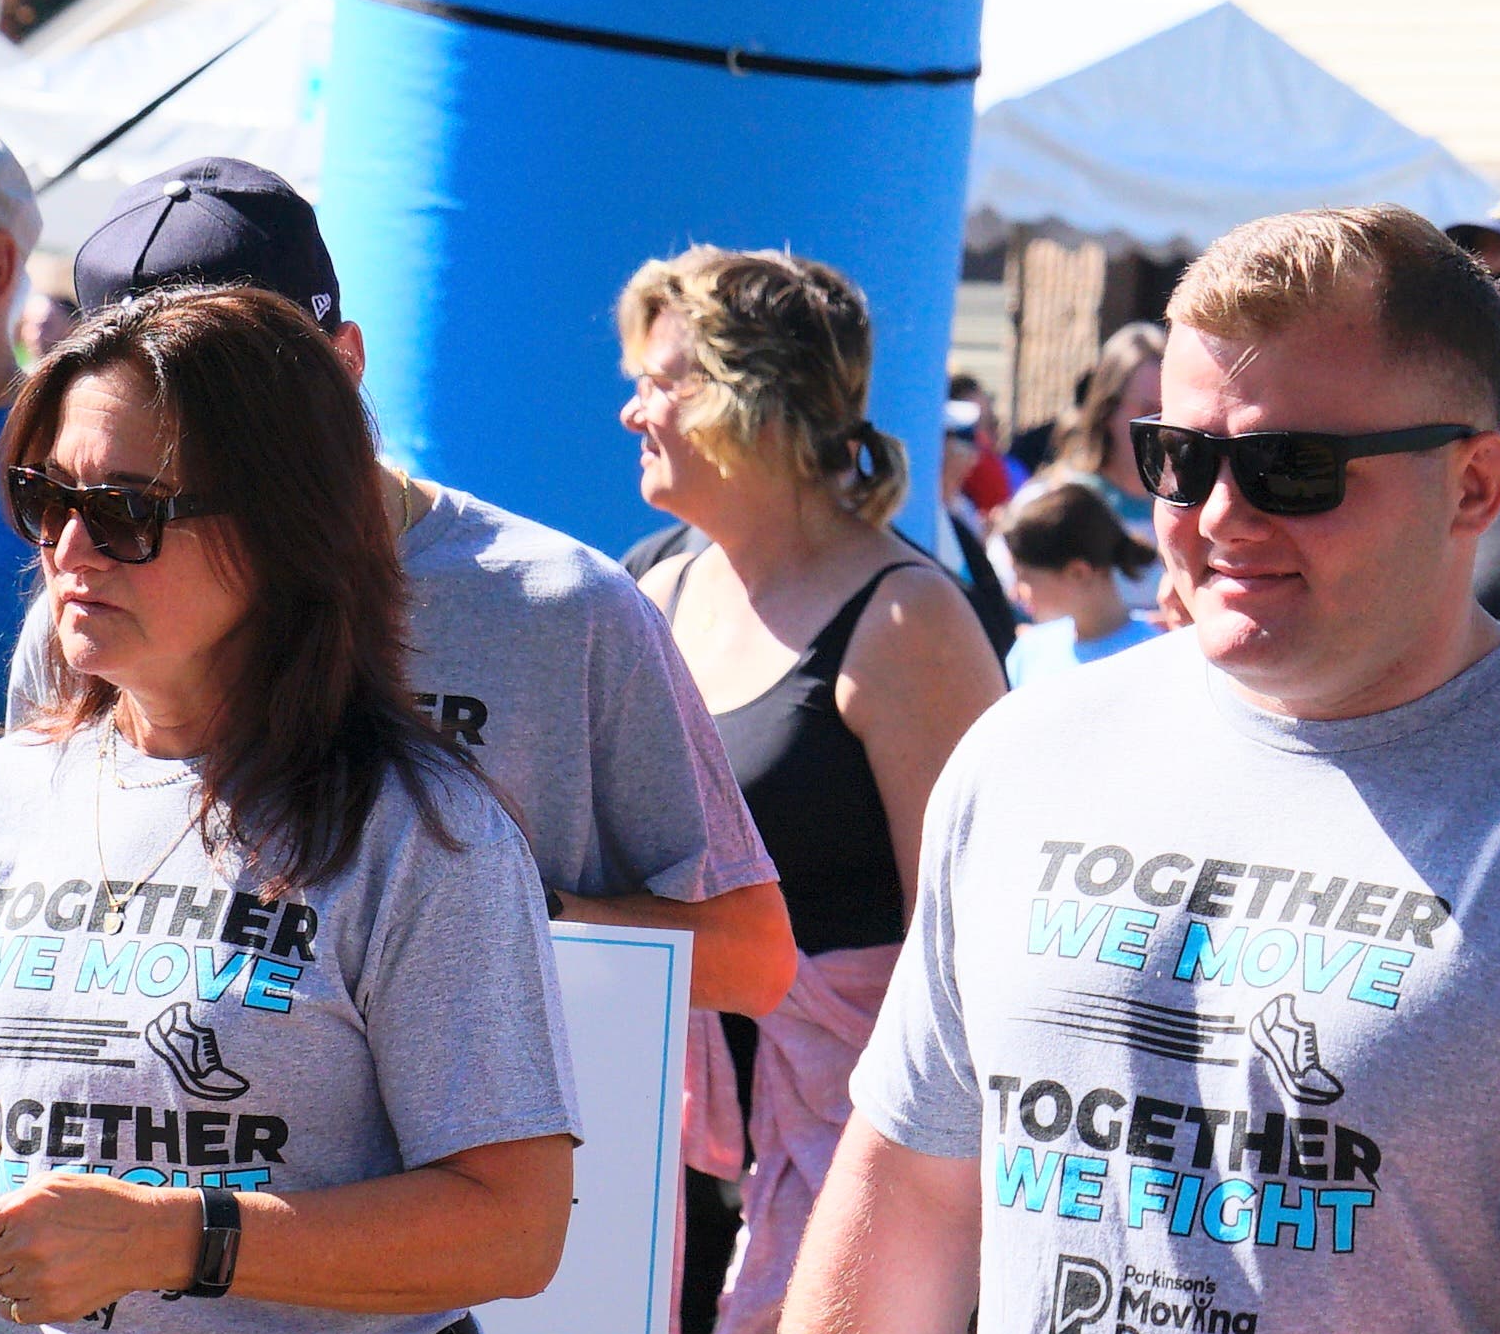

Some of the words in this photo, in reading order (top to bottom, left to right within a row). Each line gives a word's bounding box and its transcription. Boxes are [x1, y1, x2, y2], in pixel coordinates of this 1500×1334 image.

[1037, 840, 1451, 949] TOGETHER
[75, 938, 304, 1014] MOVE
[1026, 898, 1160, 972] WE
[1172, 921, 1416, 1010] MOVE
[988, 1074, 1382, 1192] TOGETHER
[997, 1143, 1108, 1222] WE
[1127, 1165, 1375, 1254] FIGHT
[1123, 1265, 1217, 1295] Parkinson's
